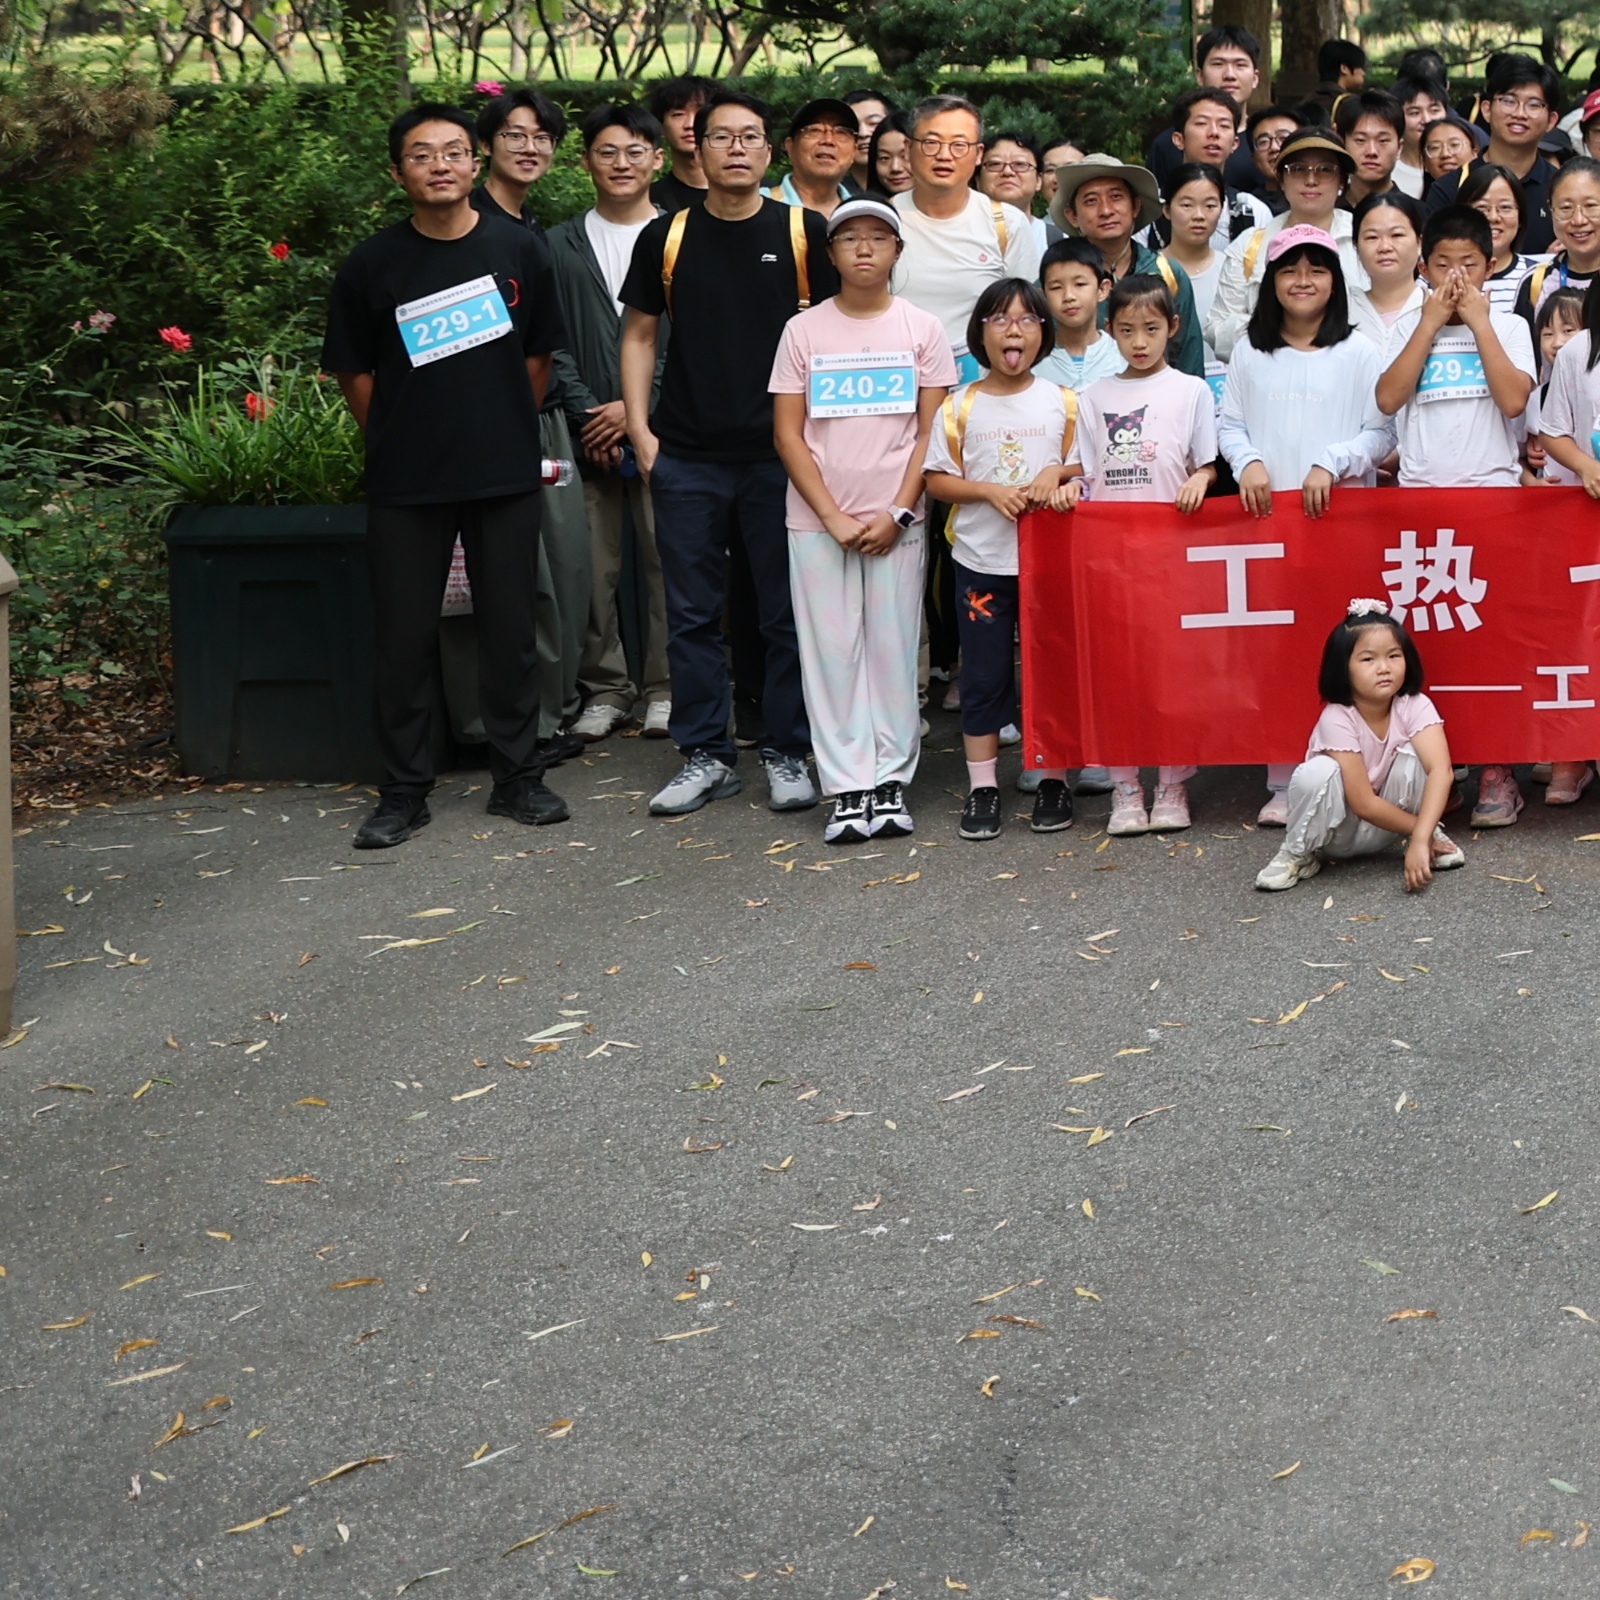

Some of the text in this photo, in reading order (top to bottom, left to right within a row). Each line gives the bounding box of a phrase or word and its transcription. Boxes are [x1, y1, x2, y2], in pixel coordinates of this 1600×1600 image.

[412, 299, 498, 347] 229-1
[819, 373, 905, 401] 240-2
[975, 424, 1047, 443] mofusand
[1106, 468, 1149, 478] KUROMI IS
